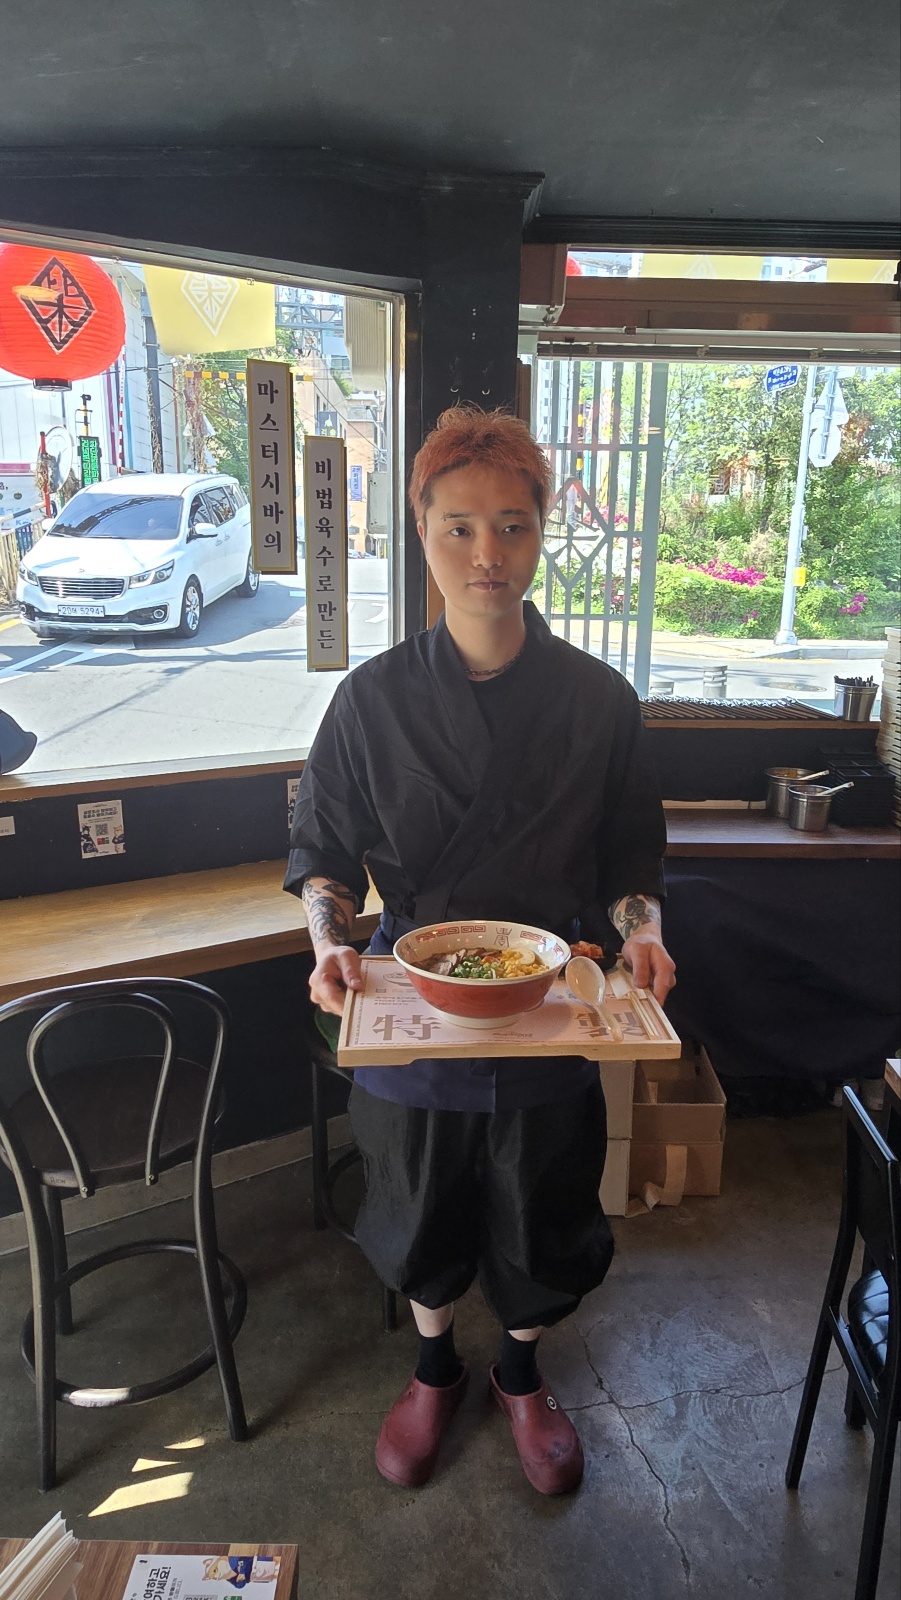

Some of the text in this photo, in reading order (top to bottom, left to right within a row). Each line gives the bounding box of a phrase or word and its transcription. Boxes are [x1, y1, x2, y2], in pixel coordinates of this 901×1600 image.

[257, 379, 284, 554] 마스터시바의
[314, 458, 337, 650] 비법육수로만든
[80, 607, 100, 615] 5294
[372, 1014, 442, 1041] 特
[143, 1568, 161, 1600] 여하고
